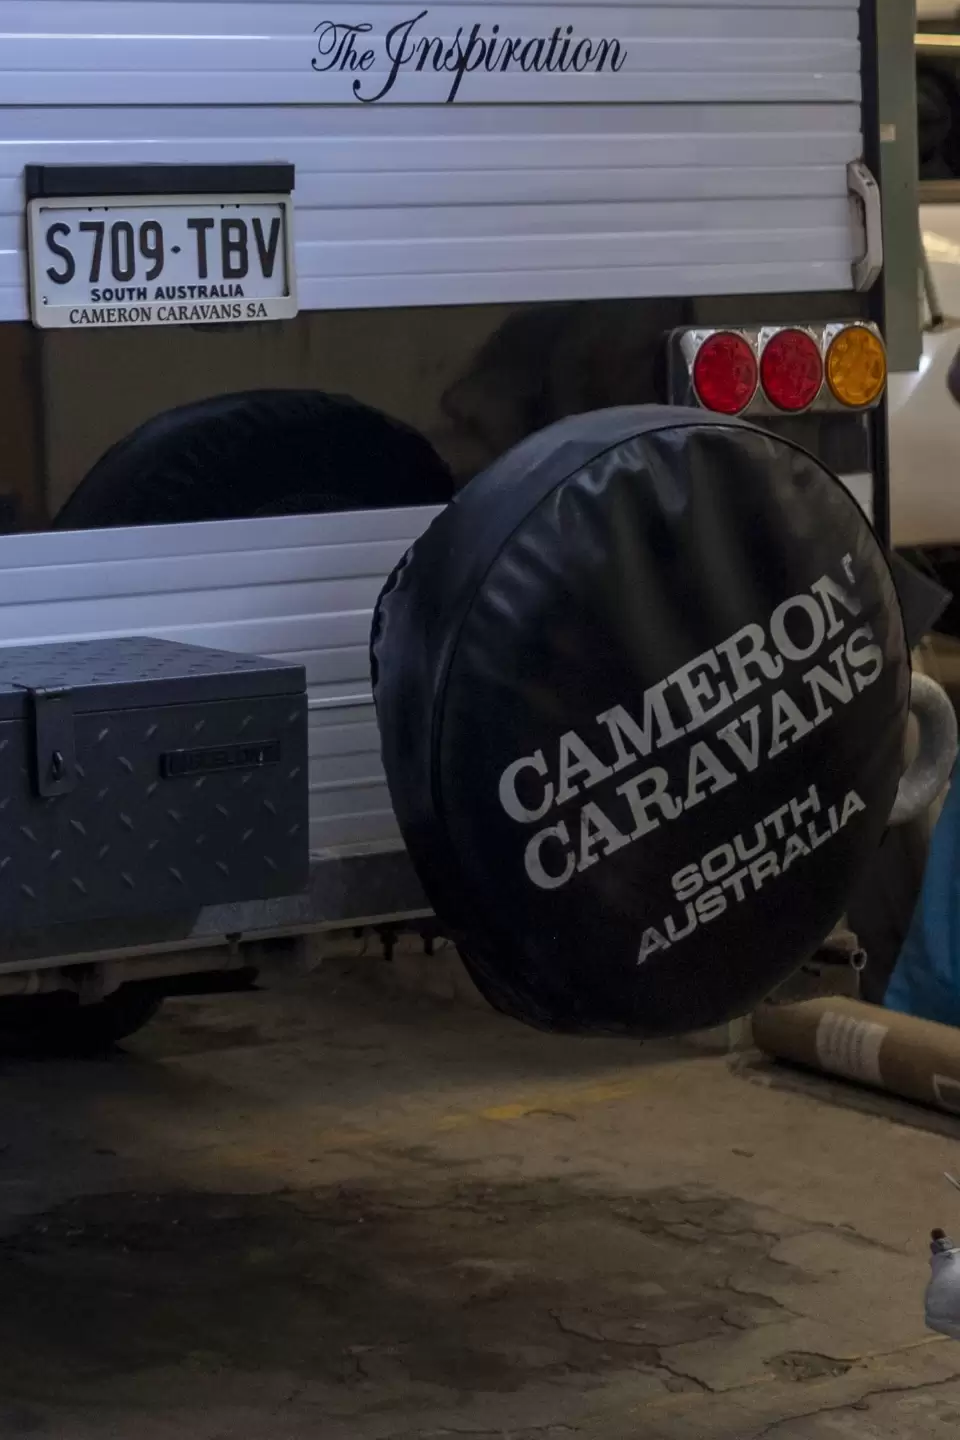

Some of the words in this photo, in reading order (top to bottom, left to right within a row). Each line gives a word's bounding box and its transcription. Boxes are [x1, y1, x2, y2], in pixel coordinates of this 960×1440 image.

[311, 21, 376, 72] The
[353, 10, 628, 102] Inspiration
[69, 307, 152, 325] CAMERON
[157, 303, 242, 322] CARAVANS
[247, 303, 268, 318] SA
[91, 287, 147, 302] SOUTH
[155, 284, 245, 300] AUSTRALIA
[498, 553, 862, 824] CAMERON
[524, 626, 883, 890] CARAVANS
[636, 789, 866, 965] AUSTRALIA
[671, 784, 821, 902] SOUTH
